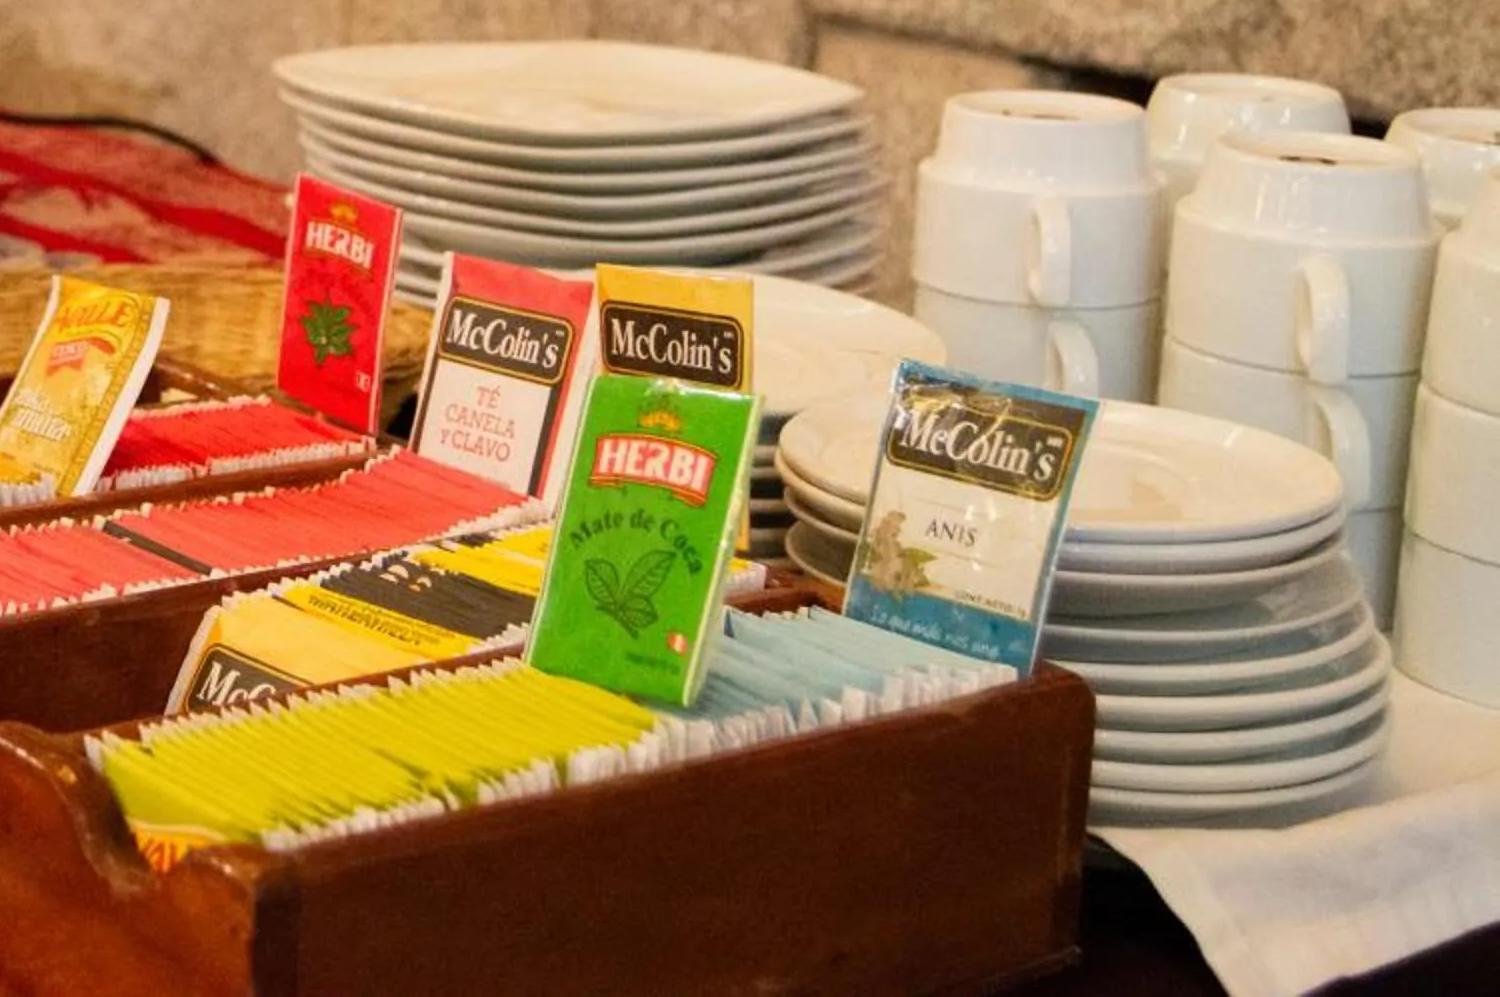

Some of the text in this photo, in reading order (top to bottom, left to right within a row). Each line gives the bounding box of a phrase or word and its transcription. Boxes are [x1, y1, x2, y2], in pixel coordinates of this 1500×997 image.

[305, 220, 375, 270] HERBI
[446, 308, 560, 369] McColin's
[610, 317, 733, 374] McColin's
[444, 403, 516, 440] CANELA
[451, 429, 511, 463] CLAVO
[899, 408, 1056, 482] McColin's
[599, 437, 710, 491] HERBI
[569, 507, 703, 577] Mate de Coca
